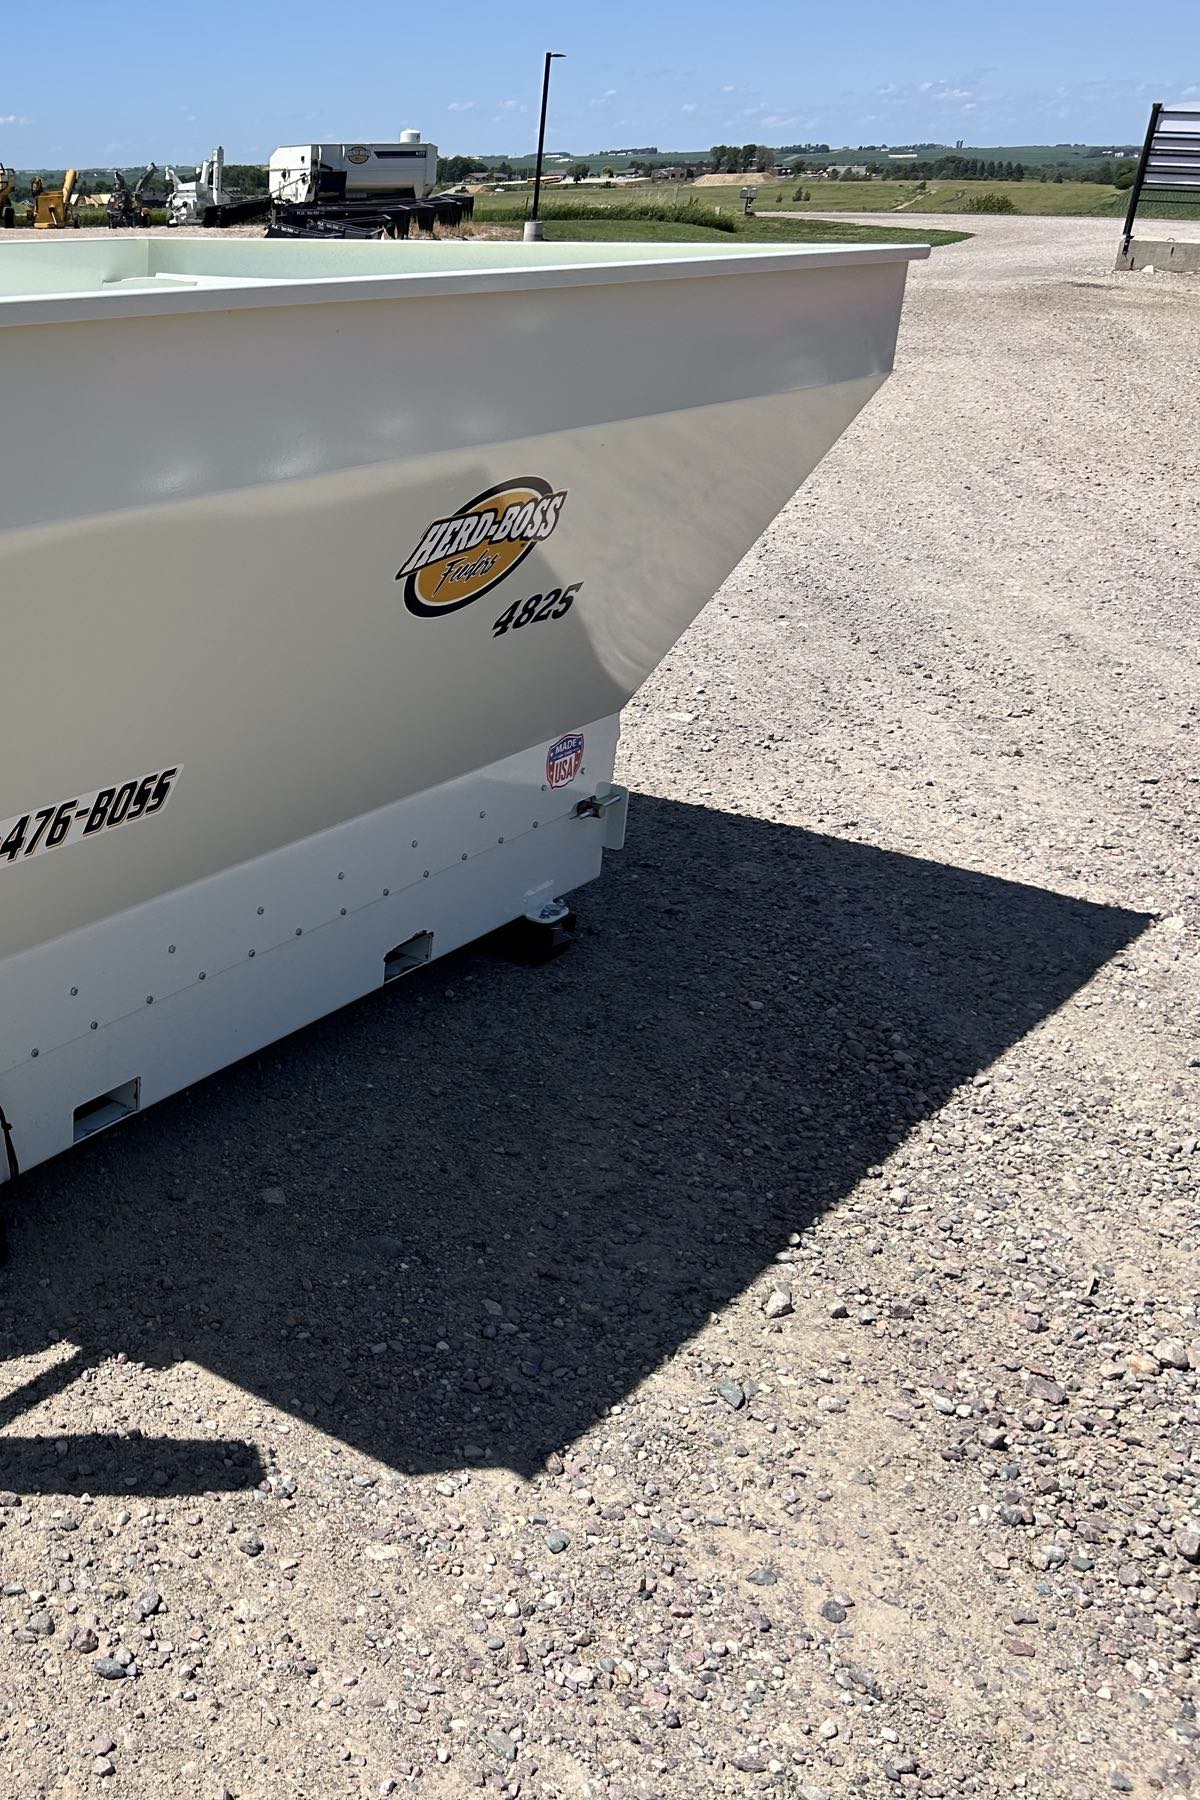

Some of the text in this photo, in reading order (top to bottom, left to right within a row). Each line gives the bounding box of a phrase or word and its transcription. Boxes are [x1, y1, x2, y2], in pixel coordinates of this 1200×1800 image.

[398, 495, 565, 577] HERD-BOSS
[432, 550, 500, 598] Feeders
[491, 582, 584, 638] 4825
[554, 756, 573, 784] USA
[555, 739, 577, 754] MADE
